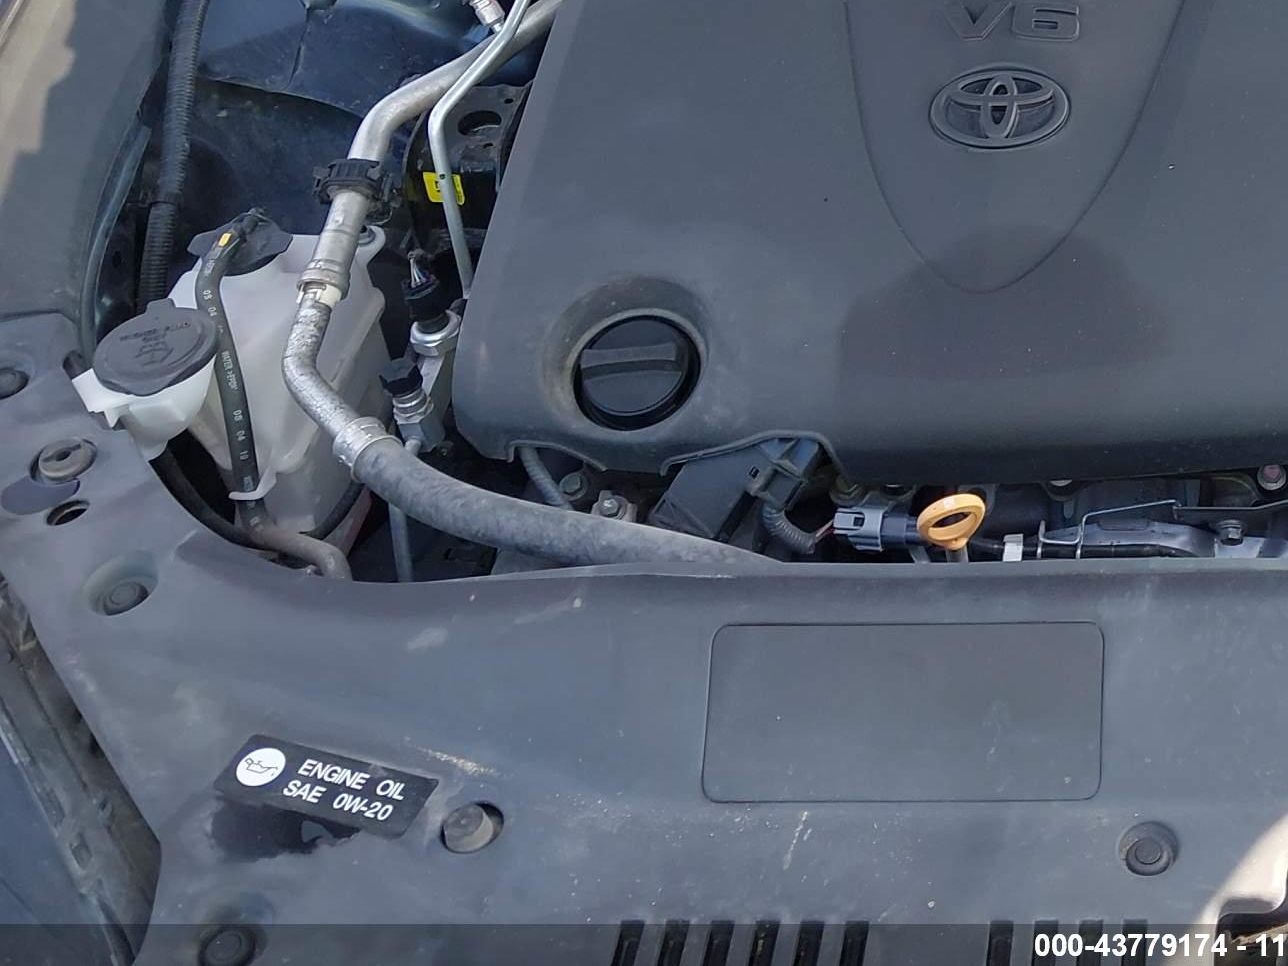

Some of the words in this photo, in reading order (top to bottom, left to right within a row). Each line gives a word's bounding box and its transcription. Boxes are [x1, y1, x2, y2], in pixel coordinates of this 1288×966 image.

[943, 1, 1080, 42] V6
[283, 780, 327, 803] SAE
[333, 794, 393, 821] 0W-20
[297, 759, 370, 790] ENGINE
[376, 779, 406, 801] OIL
